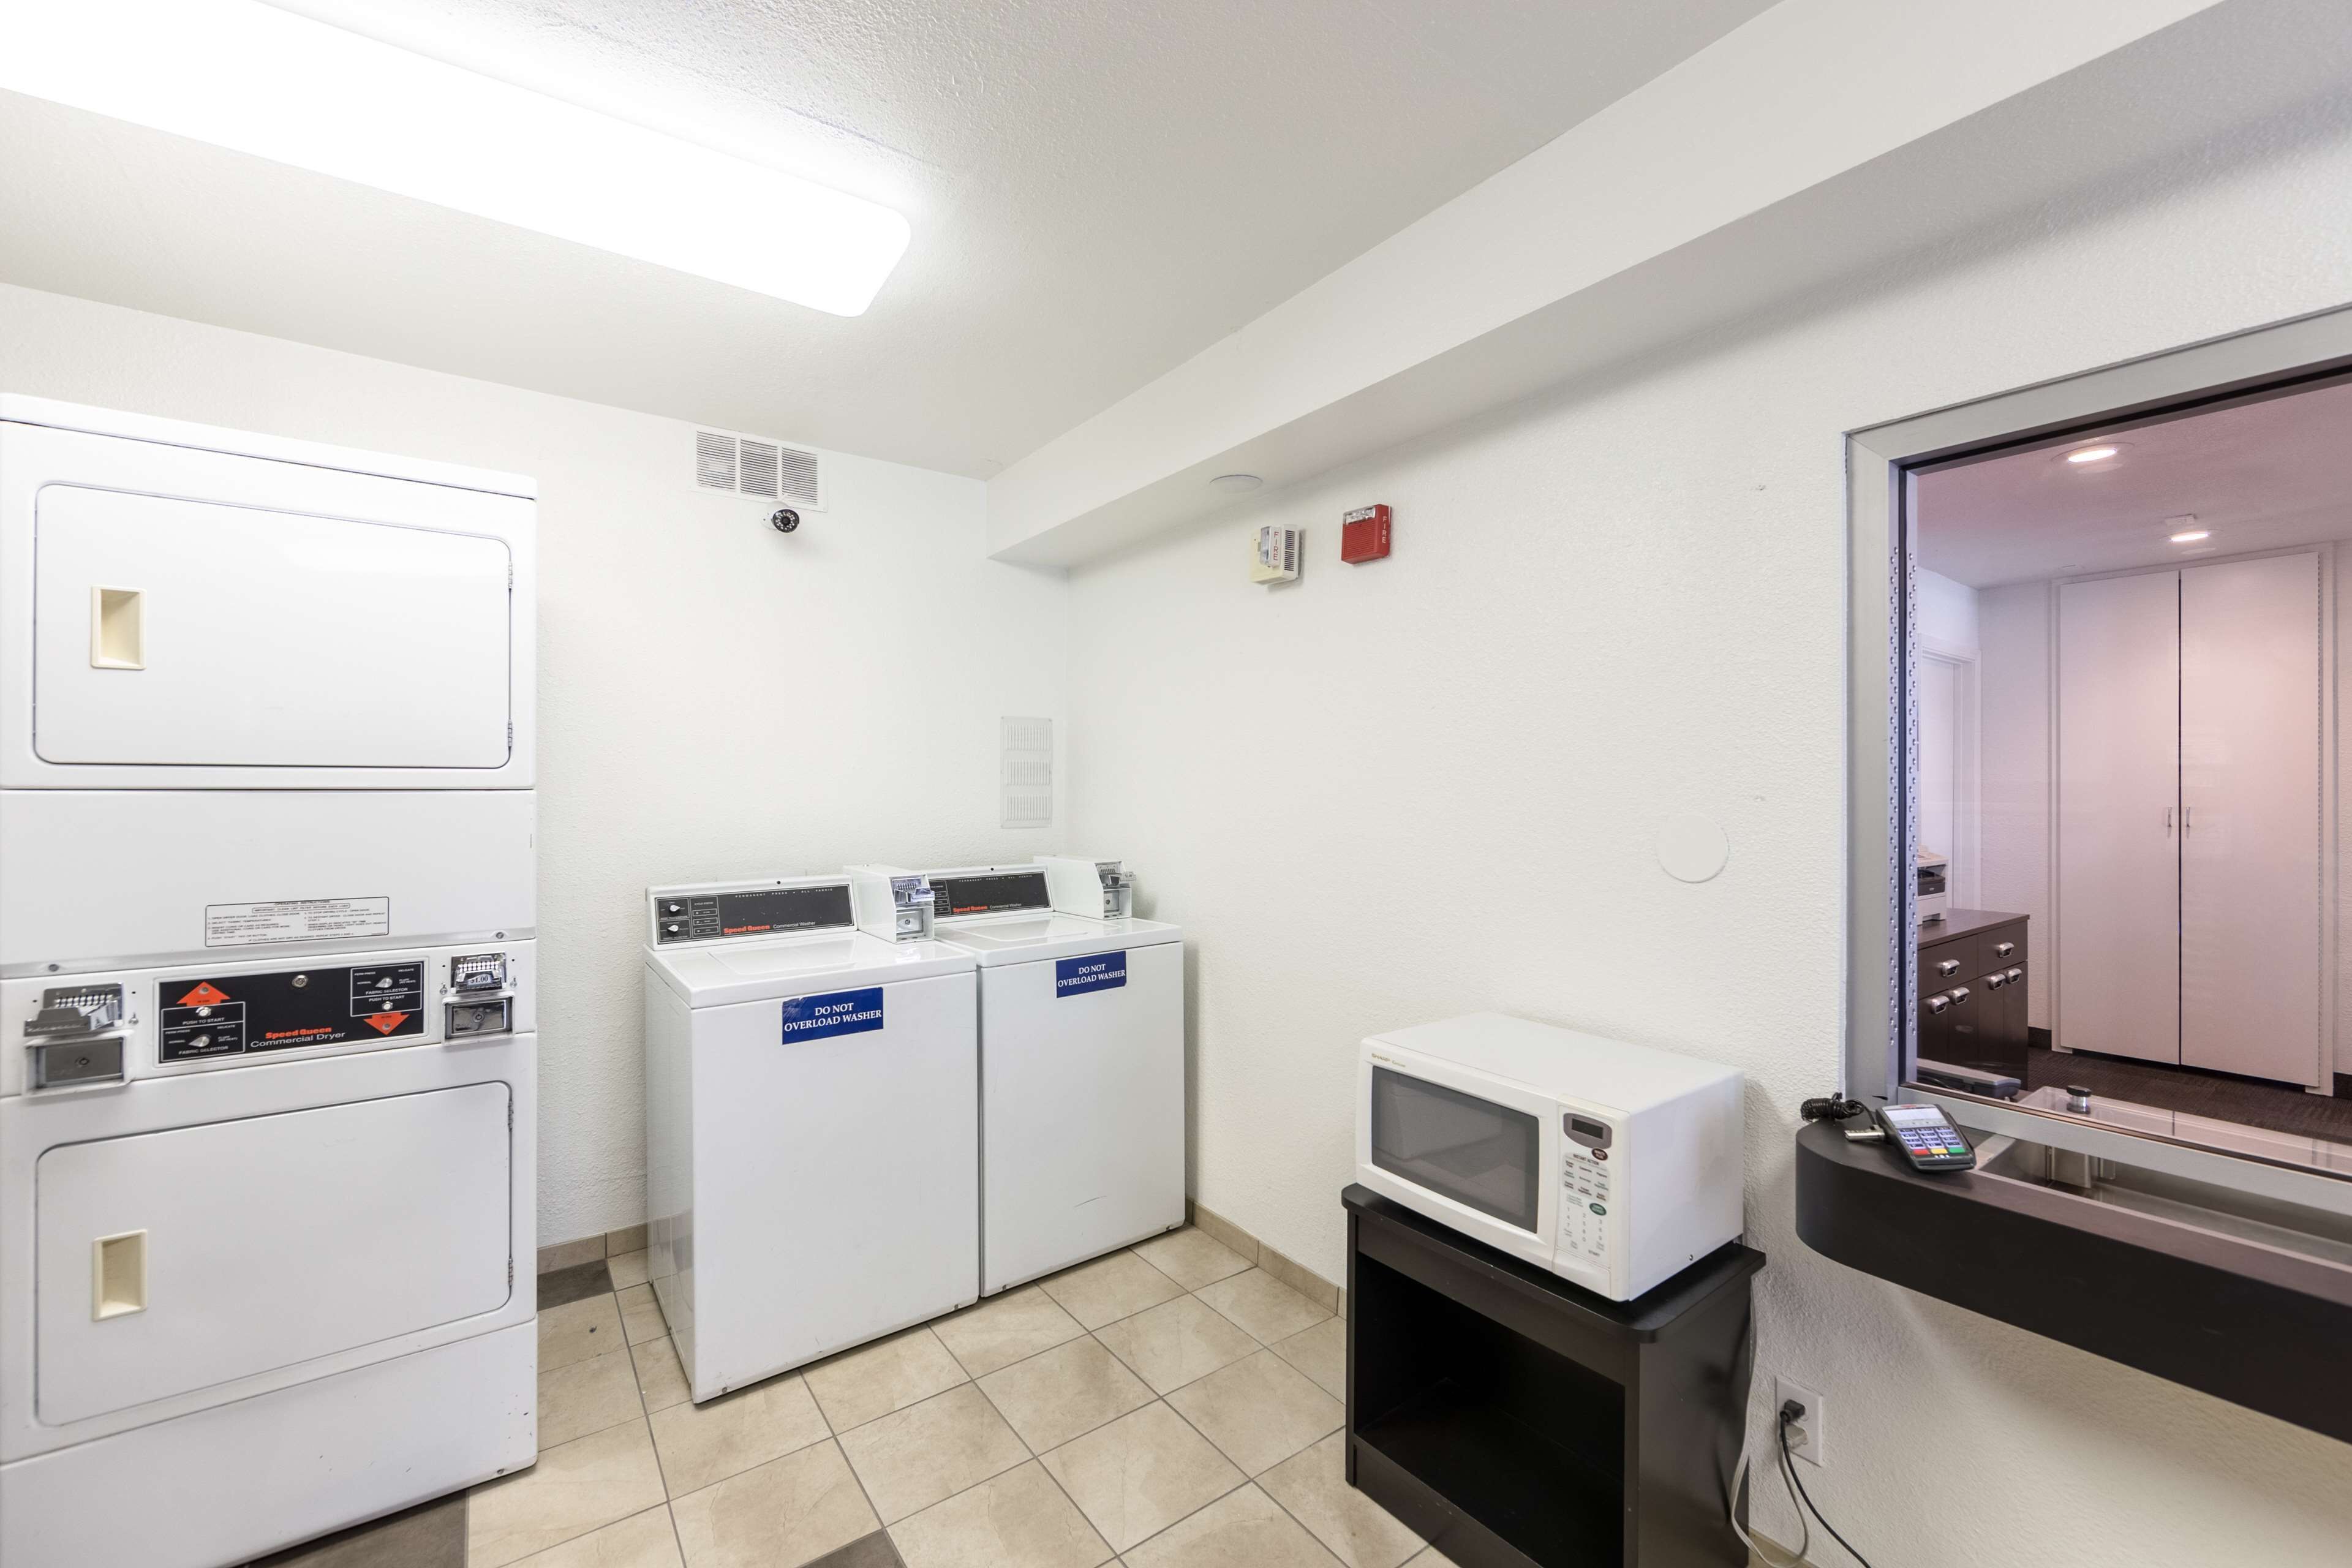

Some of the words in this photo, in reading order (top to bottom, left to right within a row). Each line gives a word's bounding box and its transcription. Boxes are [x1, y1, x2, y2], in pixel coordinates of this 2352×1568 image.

[724, 925, 747, 934] Speed
[1091, 963, 1106, 972] NOT
[1058, 974, 1097, 987] OVERLOAD
[1098, 970, 1126, 981] WASHER
[815, 1006, 831, 1016] DO
[832, 1003, 854, 1014] NOT
[784, 1016, 840, 1031] OVERLOAD
[842, 1009, 882, 1023] WASHER
[265, 1030, 299, 1039] Speed
[250, 1035, 314, 1047] Commercial
[1371, 1053, 1390, 1062] SHARP
